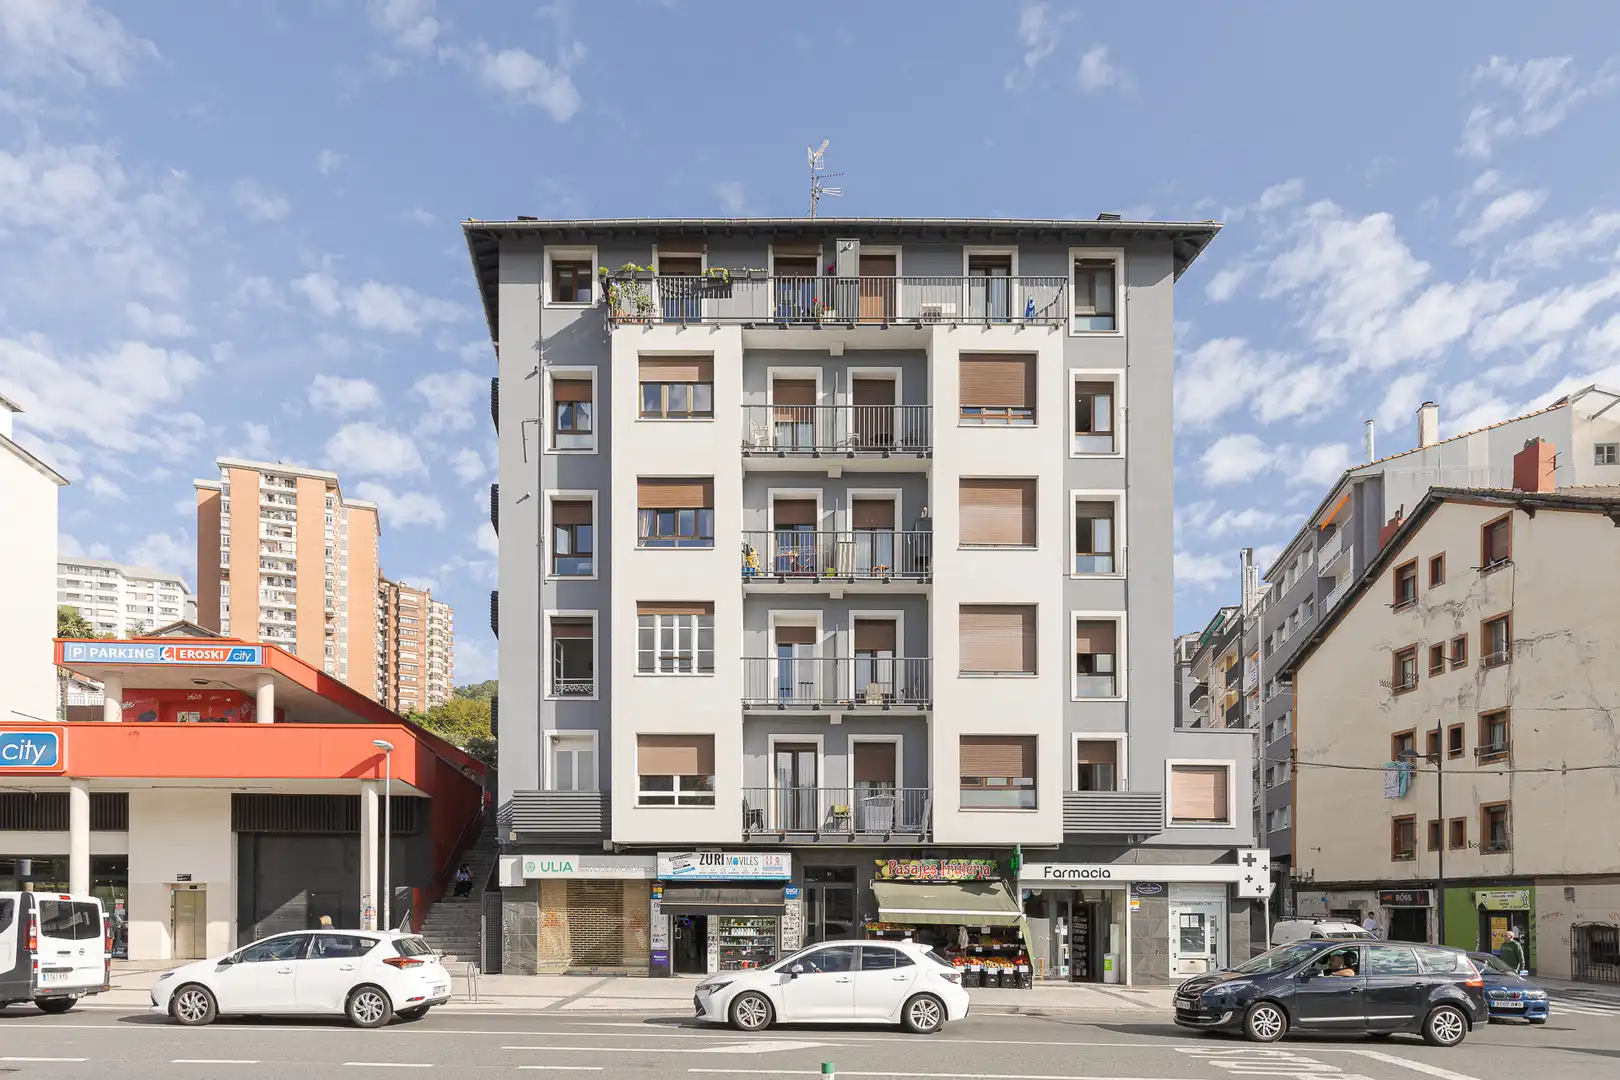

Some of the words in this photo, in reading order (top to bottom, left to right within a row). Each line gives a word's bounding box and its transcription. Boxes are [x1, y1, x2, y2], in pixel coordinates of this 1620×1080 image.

[73, 647, 82, 659] P
[90, 647, 154, 659] PARKING
[179, 649, 224, 660] EROSKI
[232, 648, 252, 662] city
[2, 738, 47, 765] city
[699, 853, 725, 866] ZURI
[540, 861, 574, 873] ULIA
[887, 859, 939, 878] Pasajes
[1044, 866, 1111, 878] Farmacia
[1395, 894, 1412, 902] BOSS
